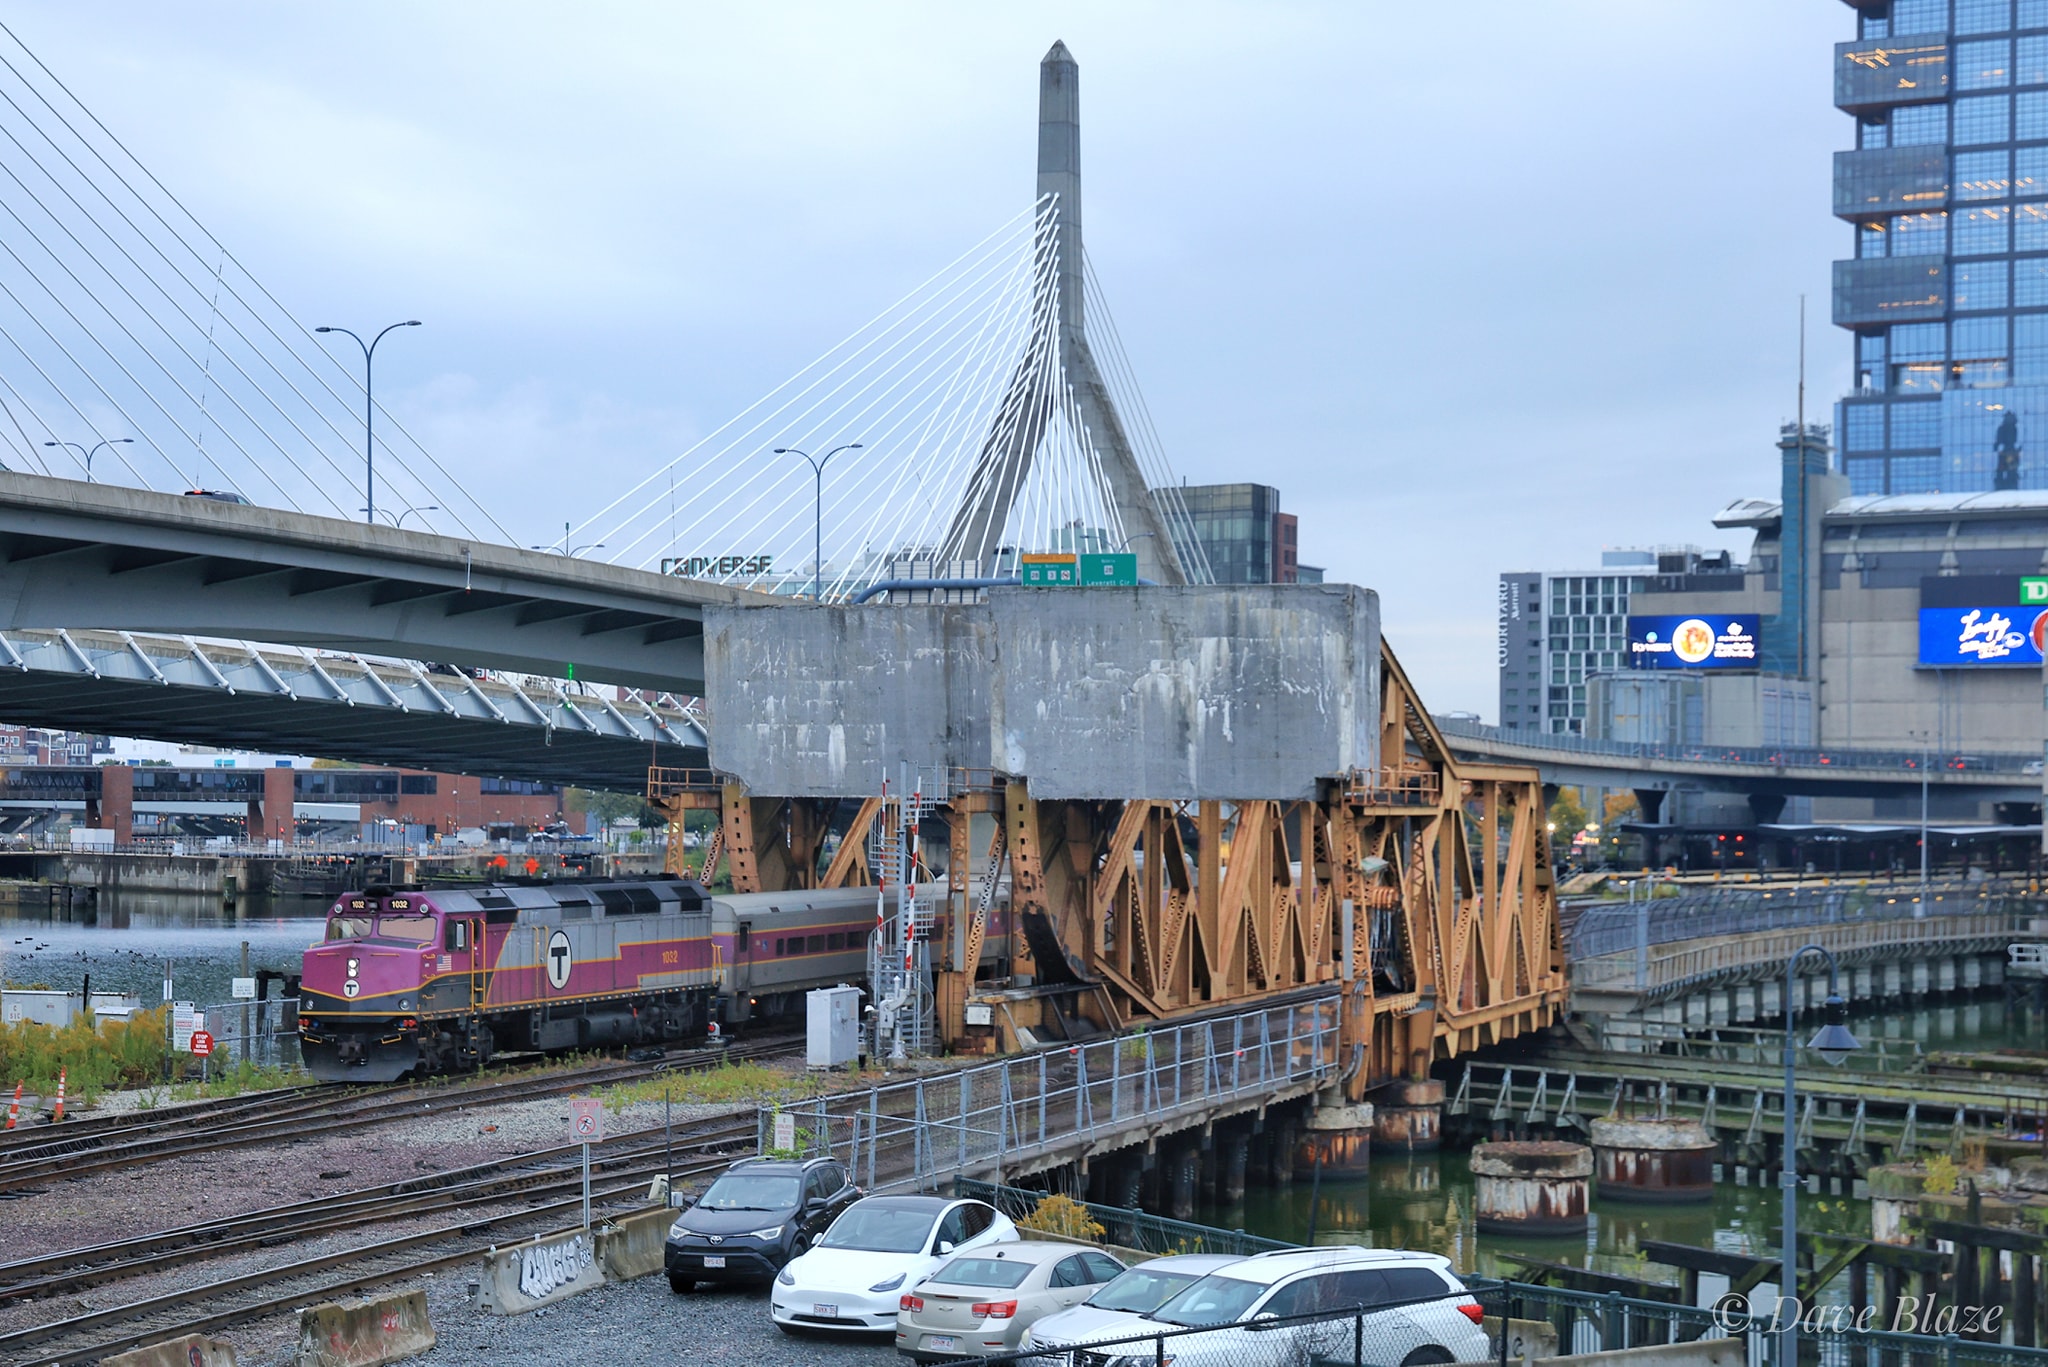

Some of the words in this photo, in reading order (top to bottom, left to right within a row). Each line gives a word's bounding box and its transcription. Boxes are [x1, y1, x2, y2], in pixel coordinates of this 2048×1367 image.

[661, 556, 772, 575] CONVERSE
[1499, 580, 1508, 668] COURTYARD
[352, 900, 365, 909] 1032
[391, 900, 408, 909] 1032
[551, 946, 567, 980] T
[662, 950, 678, 964] 1032
